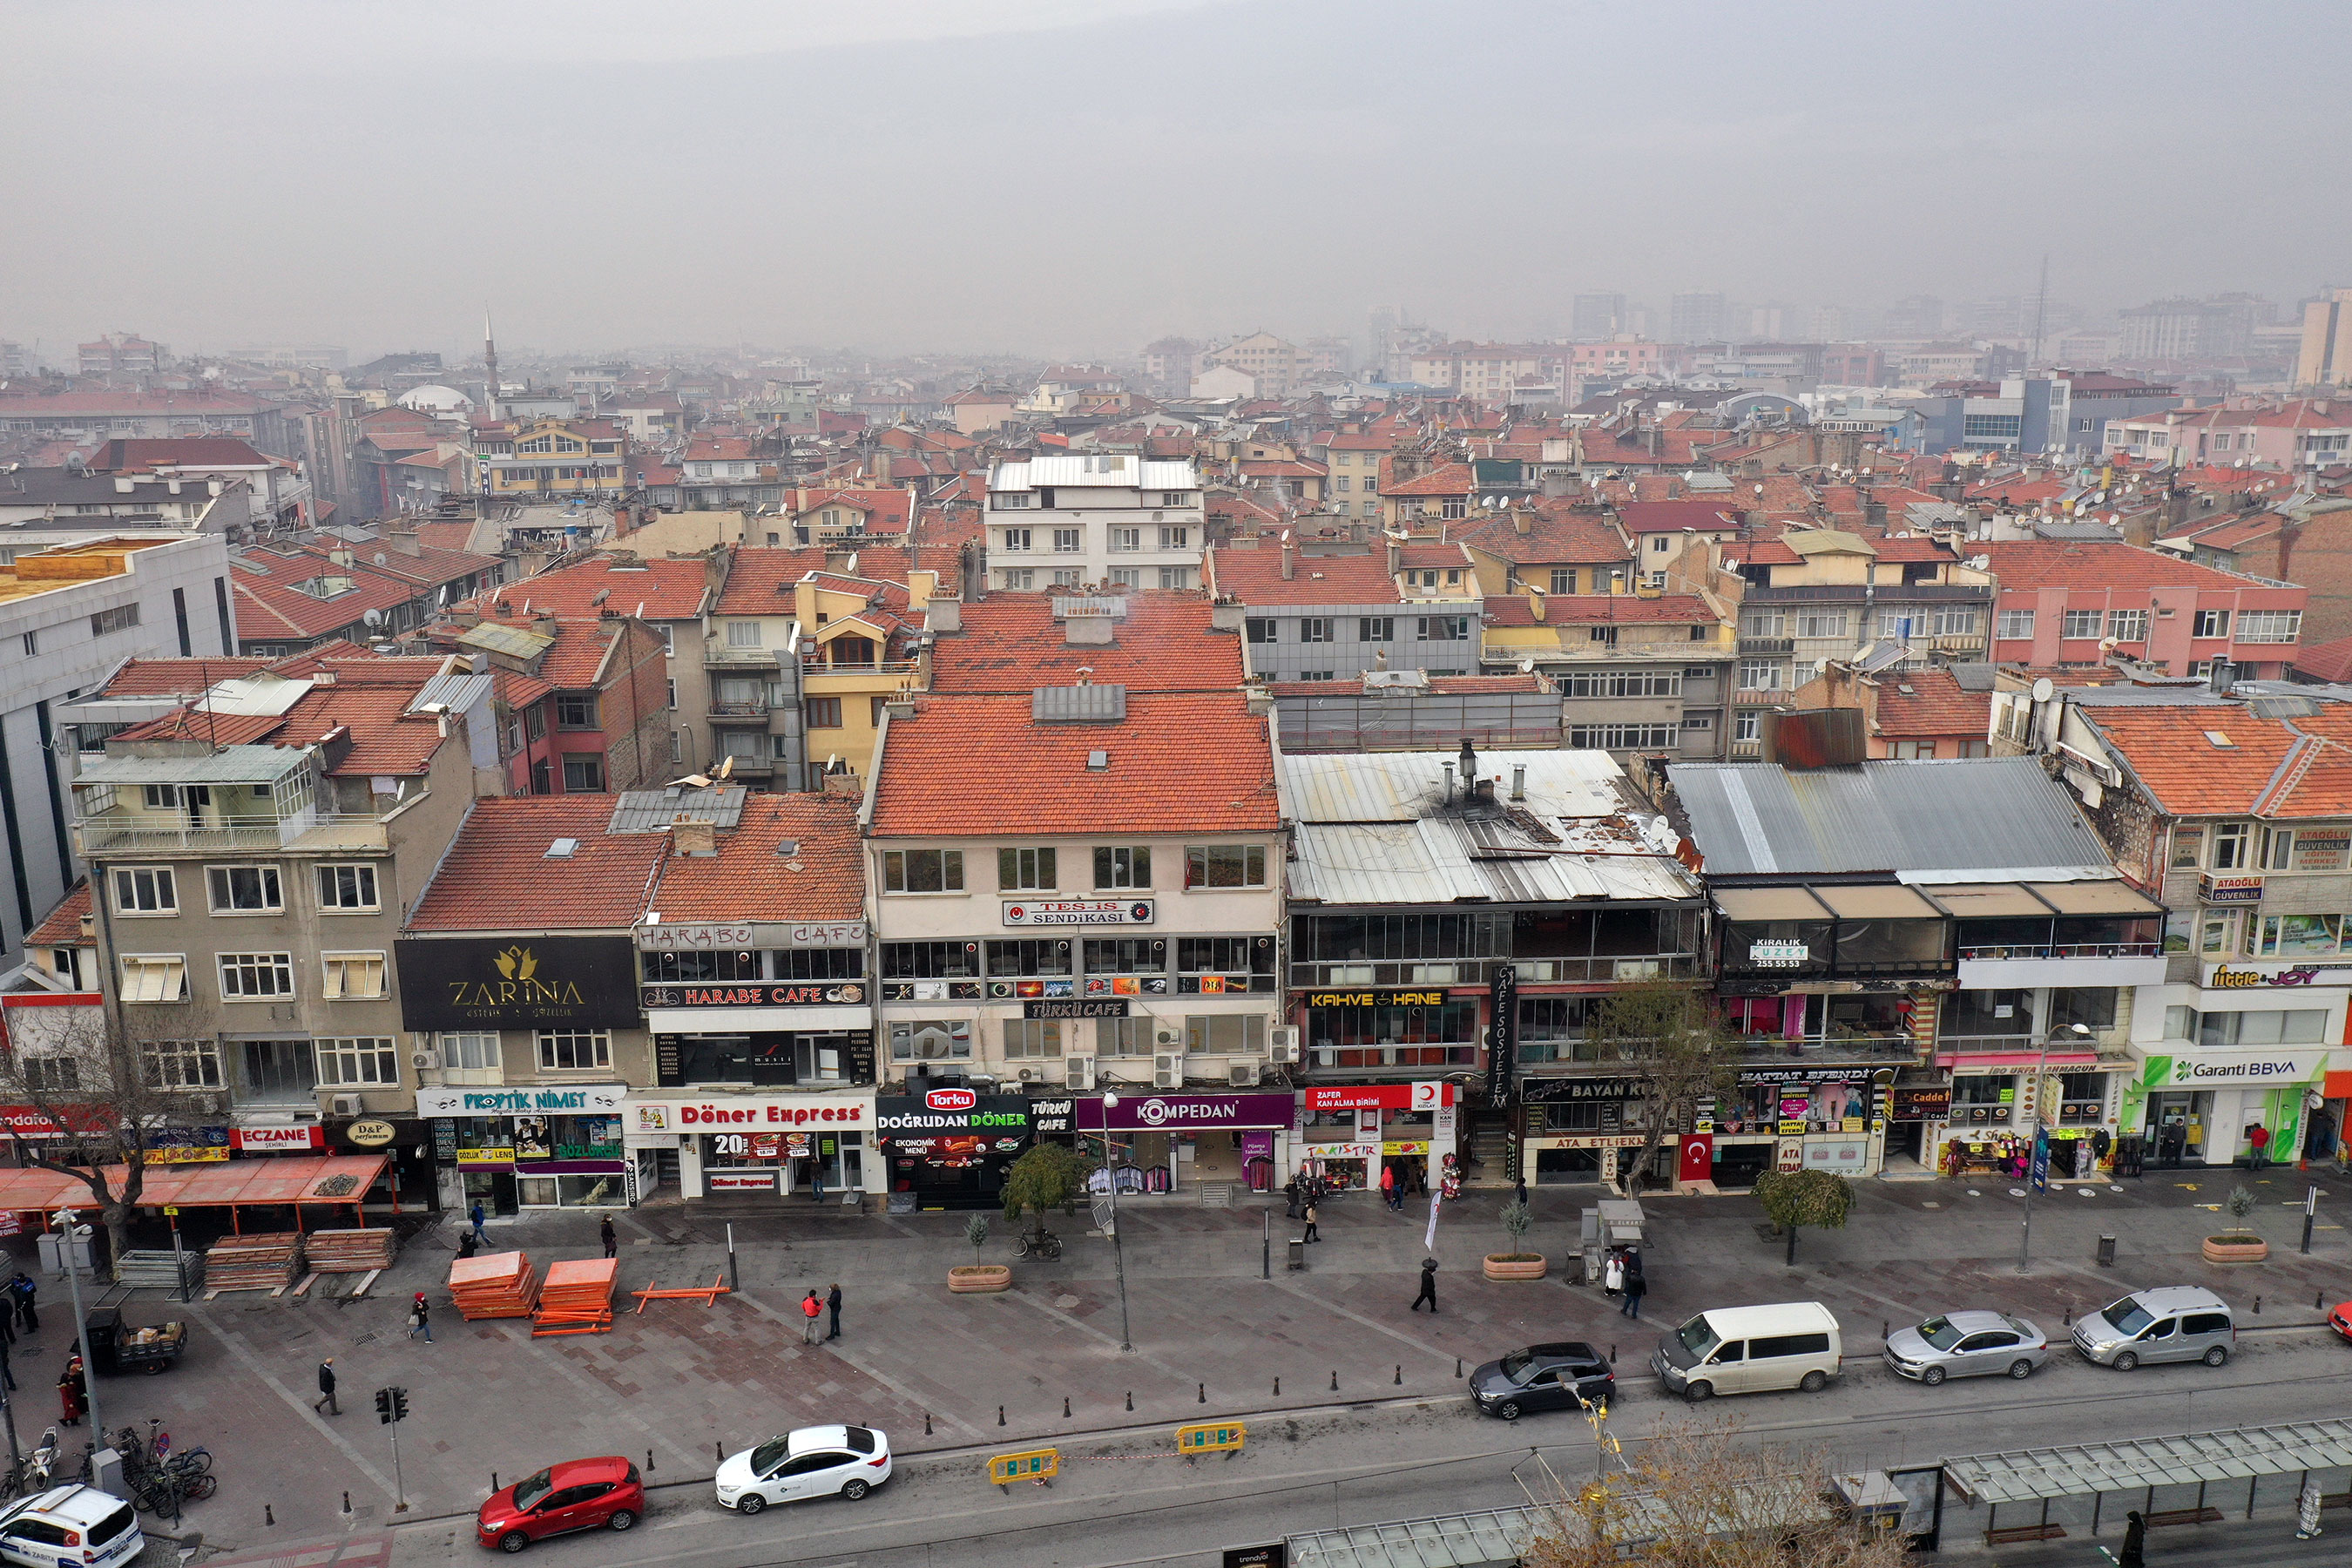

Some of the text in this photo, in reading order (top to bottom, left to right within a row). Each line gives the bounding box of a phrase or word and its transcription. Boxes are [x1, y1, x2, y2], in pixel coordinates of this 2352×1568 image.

[2299, 829, 2349, 840] ATAOĞLU
[2297, 840, 2346, 850] GÜVENLİK
[2217, 876, 2261, 888] ATAOĞLU
[2215, 889, 2260, 900] GÜVENLİK
[640, 924, 865, 947] HARABE CAFE
[2268, 970, 2319, 985] JOY
[685, 987, 822, 1004] HARABE CAFE
[1311, 992, 1442, 1007] KAHVE HANE
[1083, 1003, 1122, 1017] CAFE
[2043, 1064, 2097, 1073] AHMACUN
[2193, 1061, 2295, 1077] Garanti BBVA
[1740, 1068, 1872, 1082] HATTAT EFENDİ
[1571, 1085, 1625, 1098] BAYAN
[1913, 1092, 1943, 1102] Cadde
[535, 1088, 587, 1109] NİMET
[930, 1093, 970, 1105] Torku
[1334, 1098, 1355, 1107] ALMA
[1031, 1100, 1071, 1115] TÜRKÜ
[1137, 1099, 1236, 1124] KOMPEDAN
[0, 1113, 68, 1125] odafoe
[680, 1104, 862, 1125] Döner Express
[878, 1112, 1027, 1129] DOĞRUDAN DÖNER
[358, 1125, 383, 1133] D&P
[1037, 1119, 1066, 1131] CAFE
[242, 1128, 307, 1143] ECZANE
[265, 1140, 288, 1149] ŞEHİRLİ
[714, 1134, 743, 1154] 20
[895, 1138, 936, 1147] EKONOMİK
[1556, 1139, 1580, 1147] ATA
[458, 1150, 480, 1159] GÖZLÜK
[495, 1151, 513, 1159] LENS
[905, 1146, 928, 1154] MENÜ
[1781, 1150, 1800, 1159] ATA
[31, 1551, 57, 1563] ZABITA
[1239, 1554, 1269, 1563] trendyol
